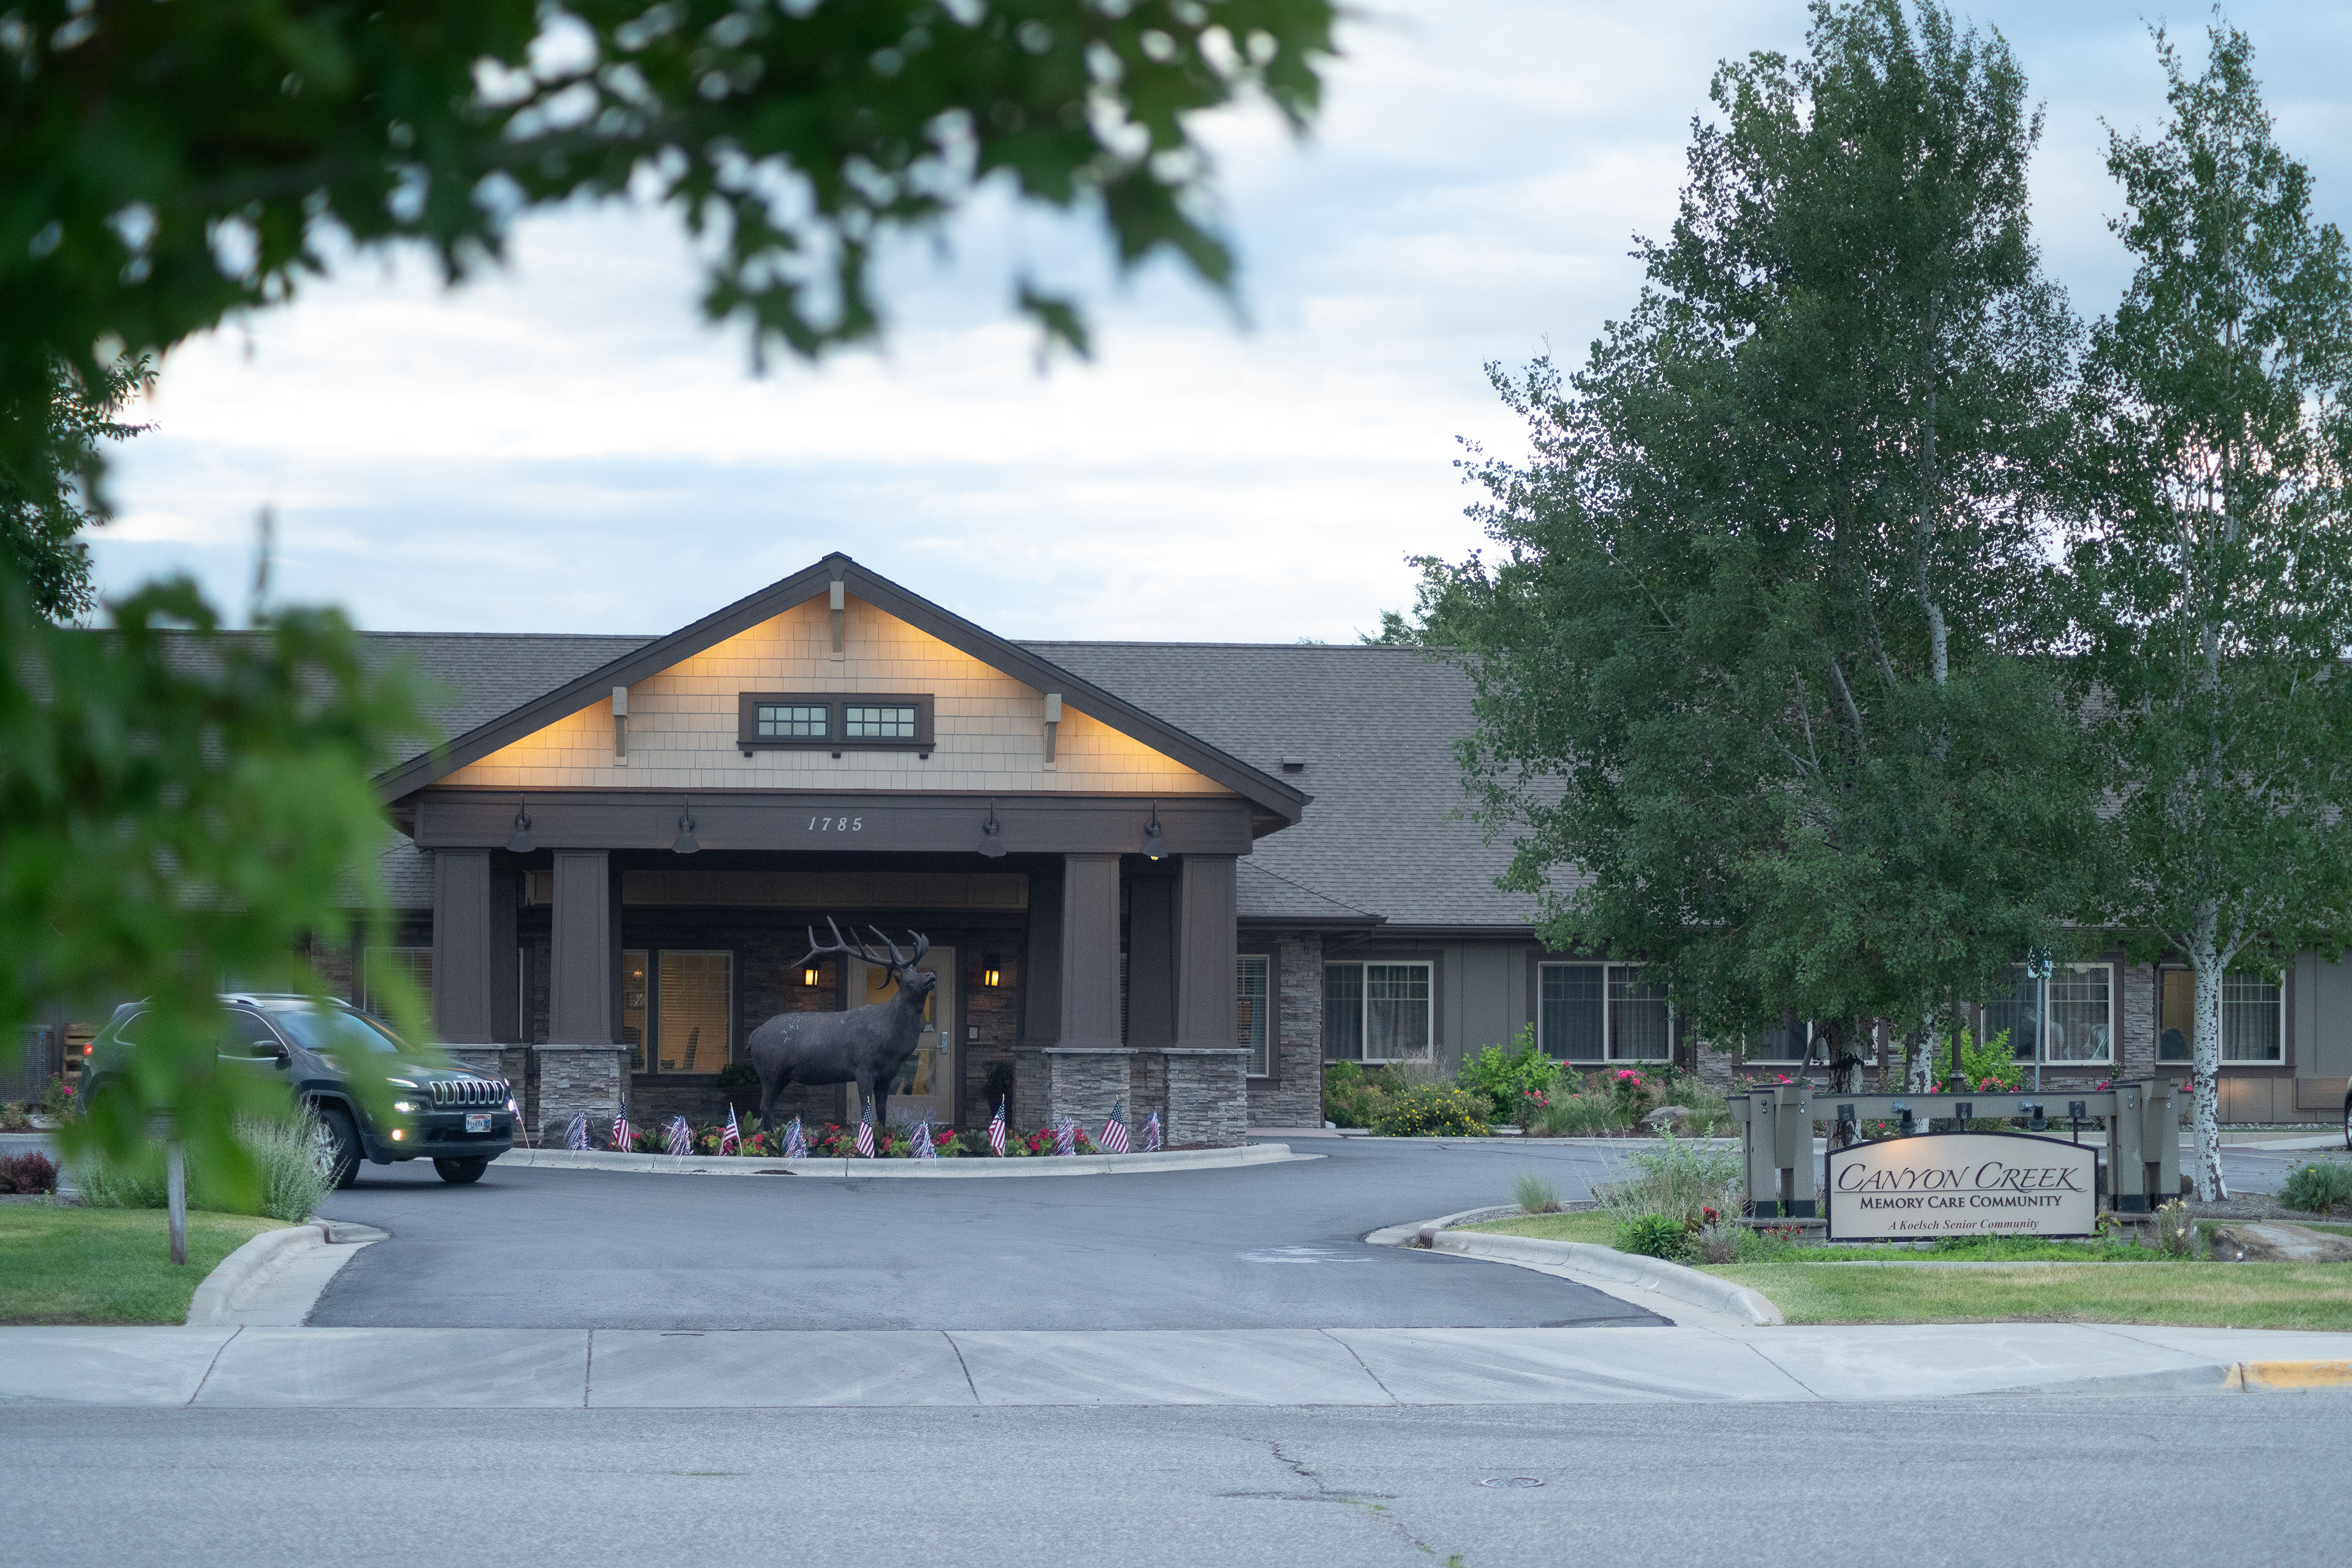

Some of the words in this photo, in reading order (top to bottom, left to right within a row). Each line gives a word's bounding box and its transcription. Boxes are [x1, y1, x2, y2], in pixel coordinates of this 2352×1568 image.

[809, 816, 862, 831] 1785
[1838, 1163, 1970, 1192] CANYON
[1975, 1161, 2087, 1193] CREEK
[1860, 1197, 1924, 1209] MEMORY
[1928, 1196, 1966, 1208] CARE
[1969, 1195, 2063, 1207] COMMUNITY
[1888, 1221, 1896, 1230] A
[1899, 1220, 1939, 1230] Koelsch
[1943, 1219, 1977, 1229] Senior
[1980, 1218, 2039, 1230] Community
